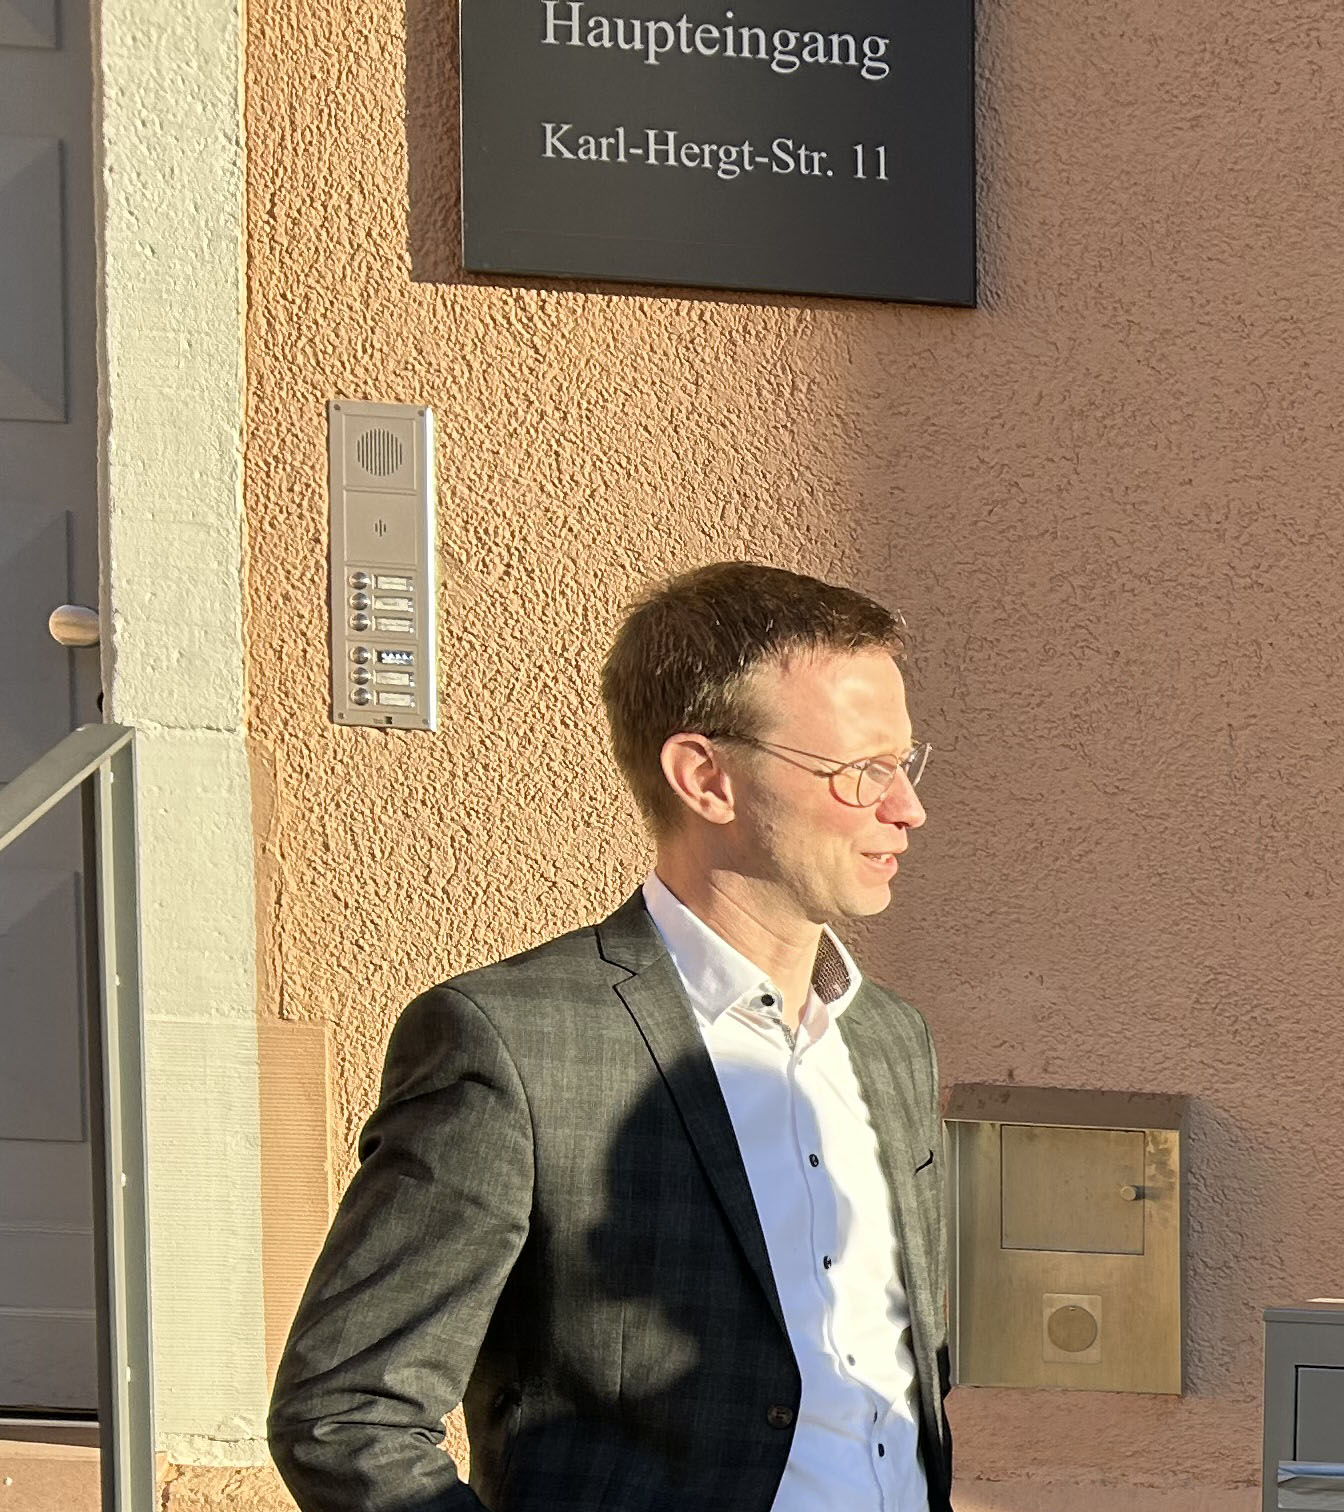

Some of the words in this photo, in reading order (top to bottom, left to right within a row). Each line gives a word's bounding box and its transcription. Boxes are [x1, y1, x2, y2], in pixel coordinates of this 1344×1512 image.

[541, 0, 890, 80] Haupteingang
[541, 122, 834, 179] Karl-Hergt-Str.
[853, 144, 889, 180] 11
